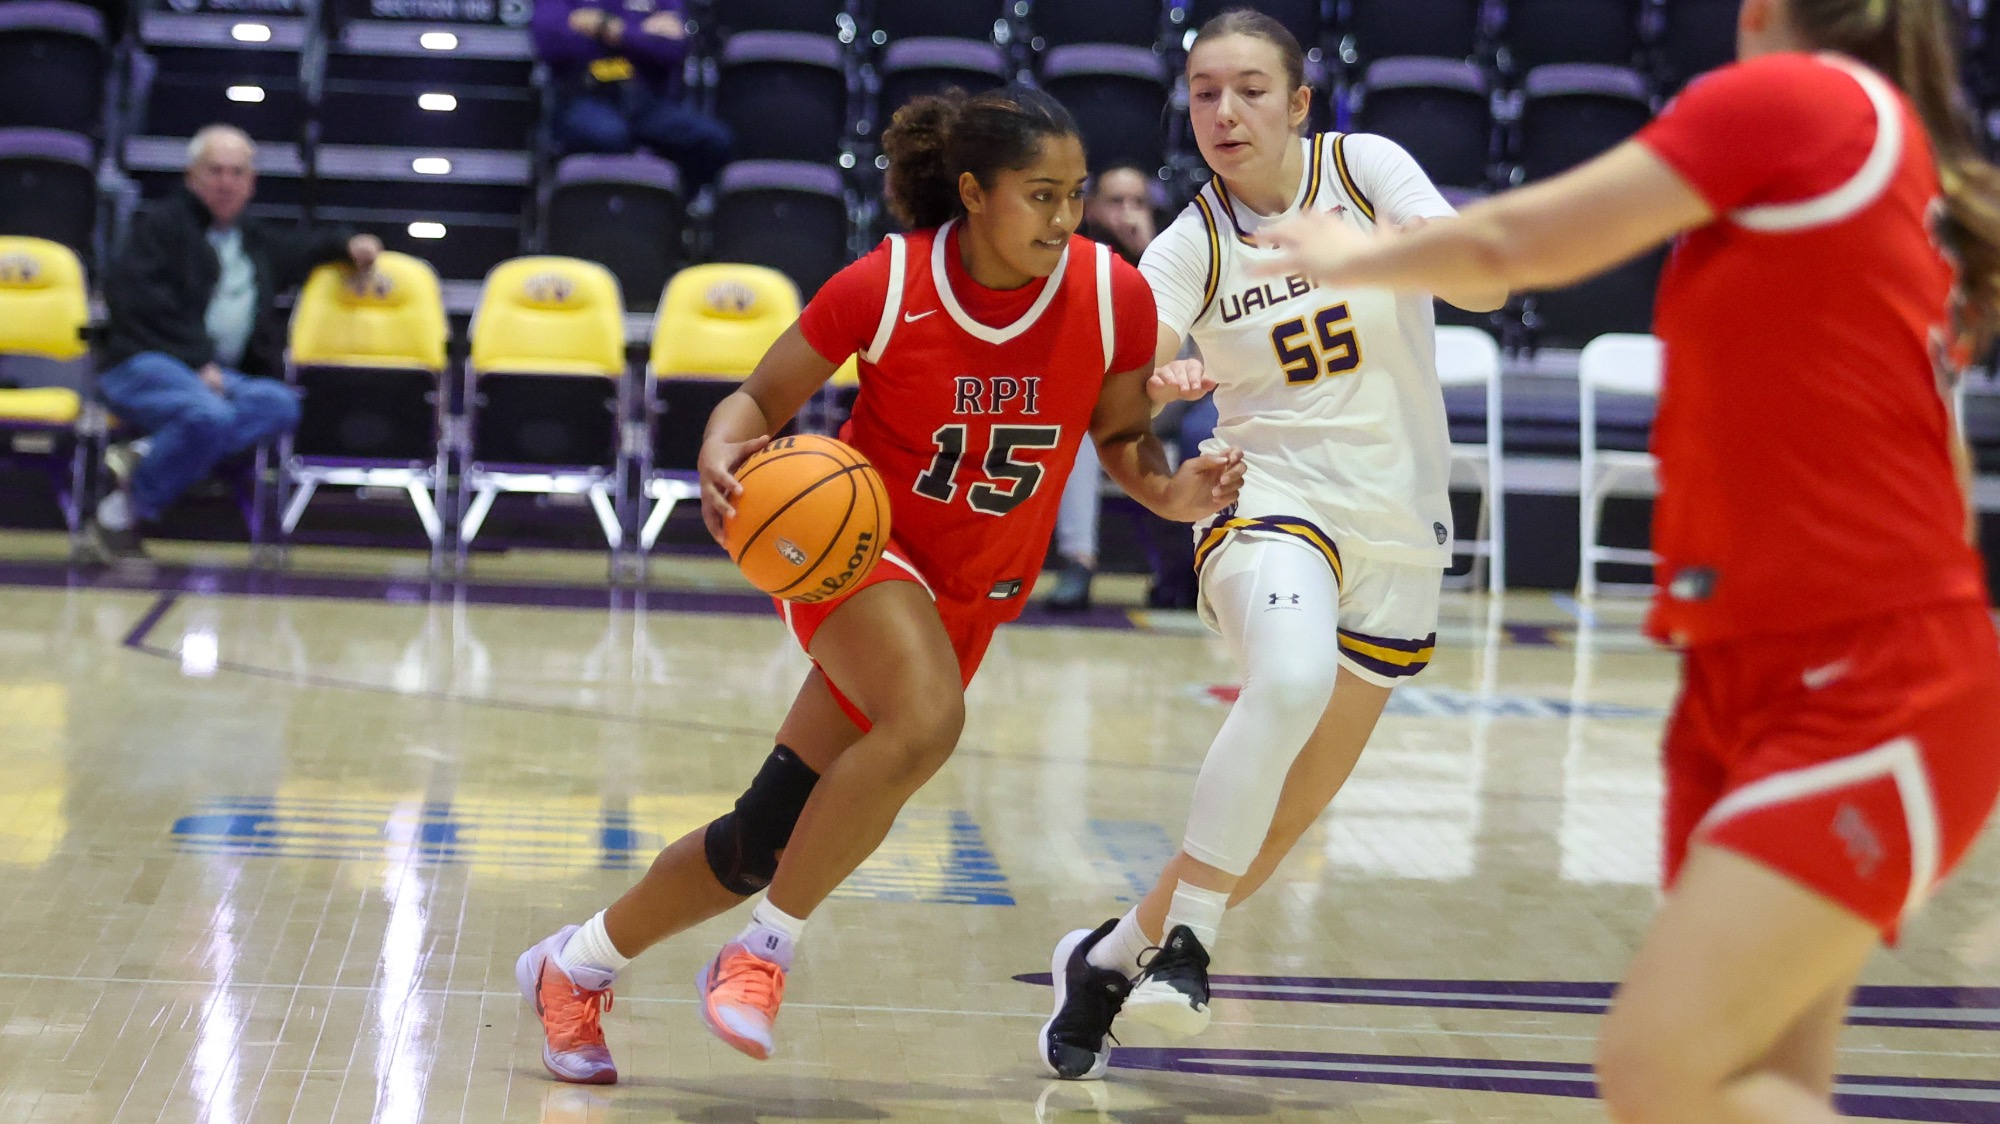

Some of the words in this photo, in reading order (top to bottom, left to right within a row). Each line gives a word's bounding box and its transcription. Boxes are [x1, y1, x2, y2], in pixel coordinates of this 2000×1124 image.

[1219, 273, 1320, 323] UALB
[1268, 300, 1363, 386] 55
[952, 376, 1041, 415] RPI
[911, 423, 1061, 517] 15
